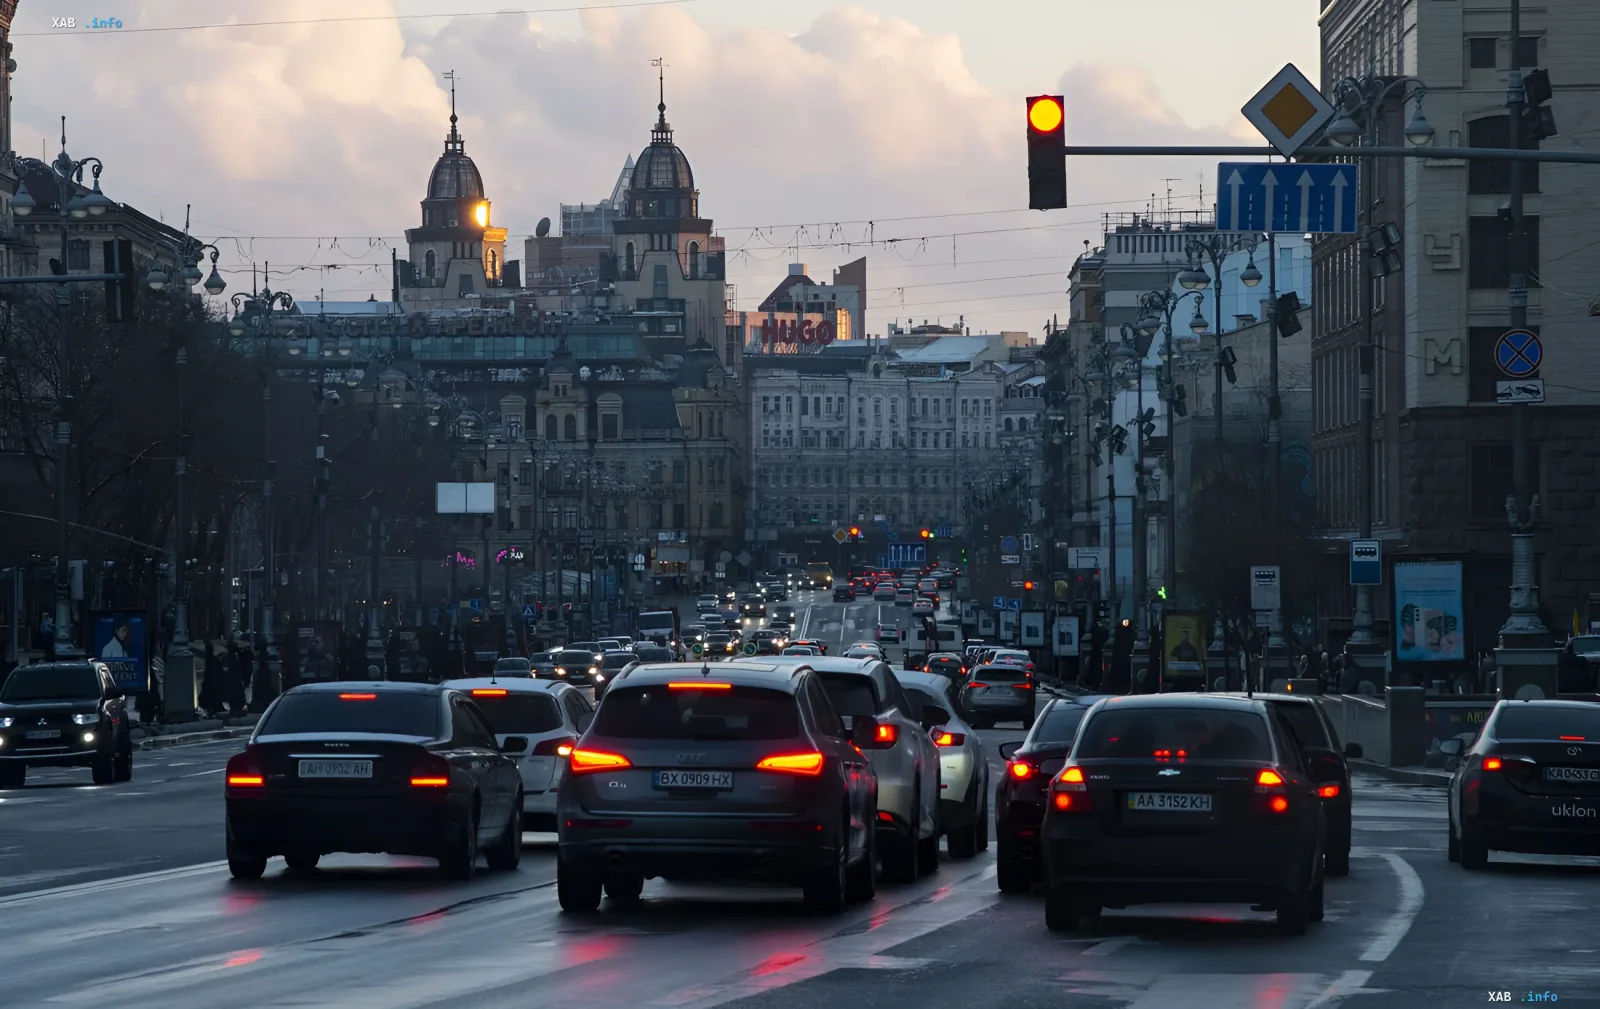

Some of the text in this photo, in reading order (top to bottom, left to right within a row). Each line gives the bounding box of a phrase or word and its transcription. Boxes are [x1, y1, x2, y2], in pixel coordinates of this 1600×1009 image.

[763, 319, 834, 345] HUGO
[660, 773, 730, 786] BX 0909 HX
[1137, 795, 1210, 809] AA 3152 KH
[1552, 803, 1596, 818] uklon
